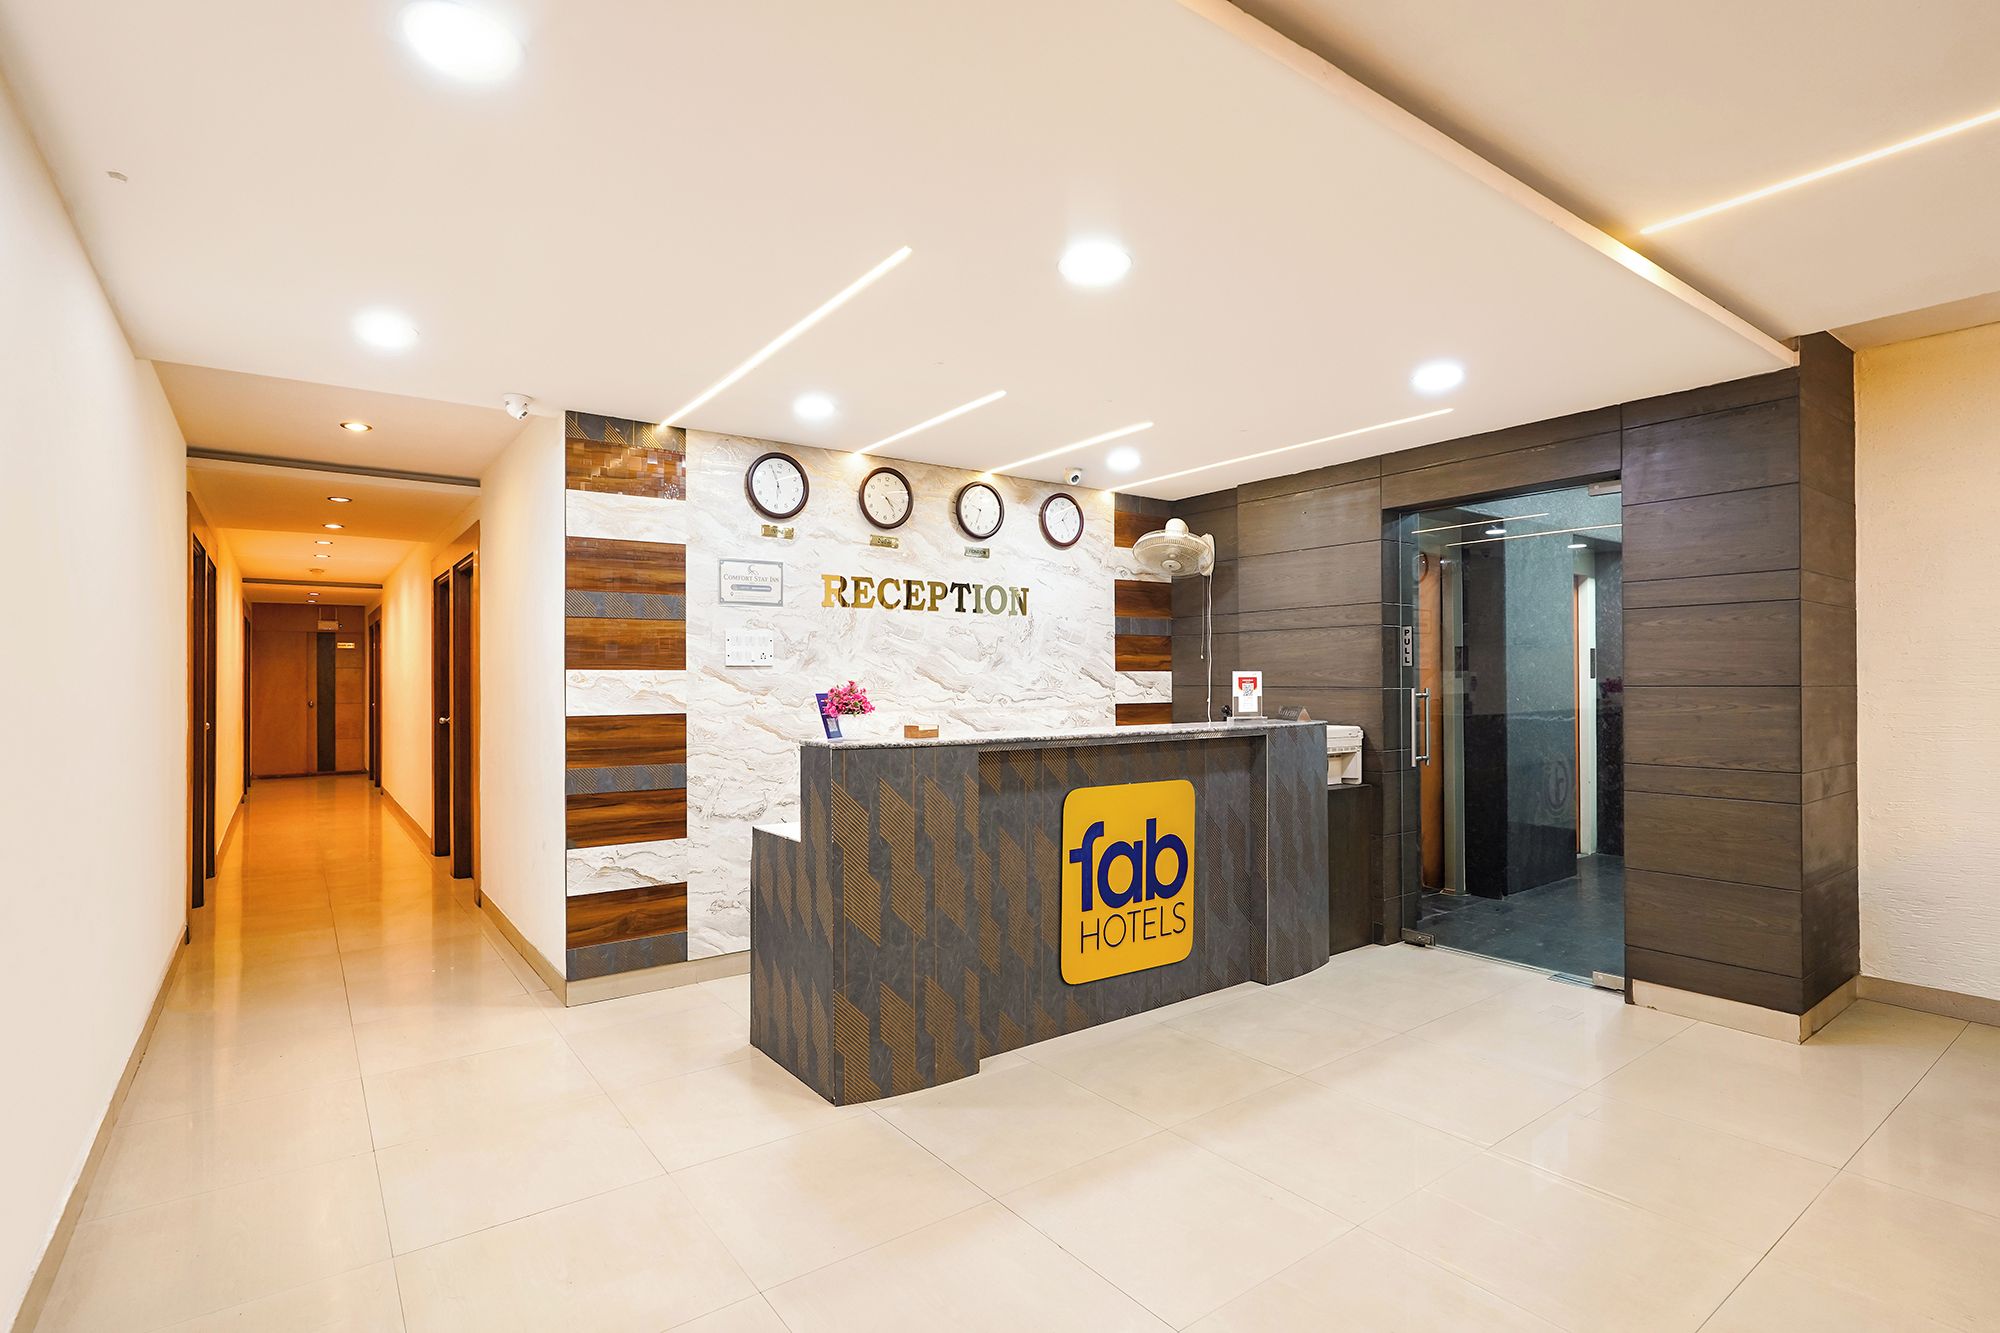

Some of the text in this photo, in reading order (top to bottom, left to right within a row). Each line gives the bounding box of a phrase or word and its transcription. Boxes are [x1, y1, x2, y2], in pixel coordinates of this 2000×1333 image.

[821, 574, 1029, 616] RECEPTION
[1069, 817, 1189, 912] fab
[1081, 902, 1186, 954] HOTELS
